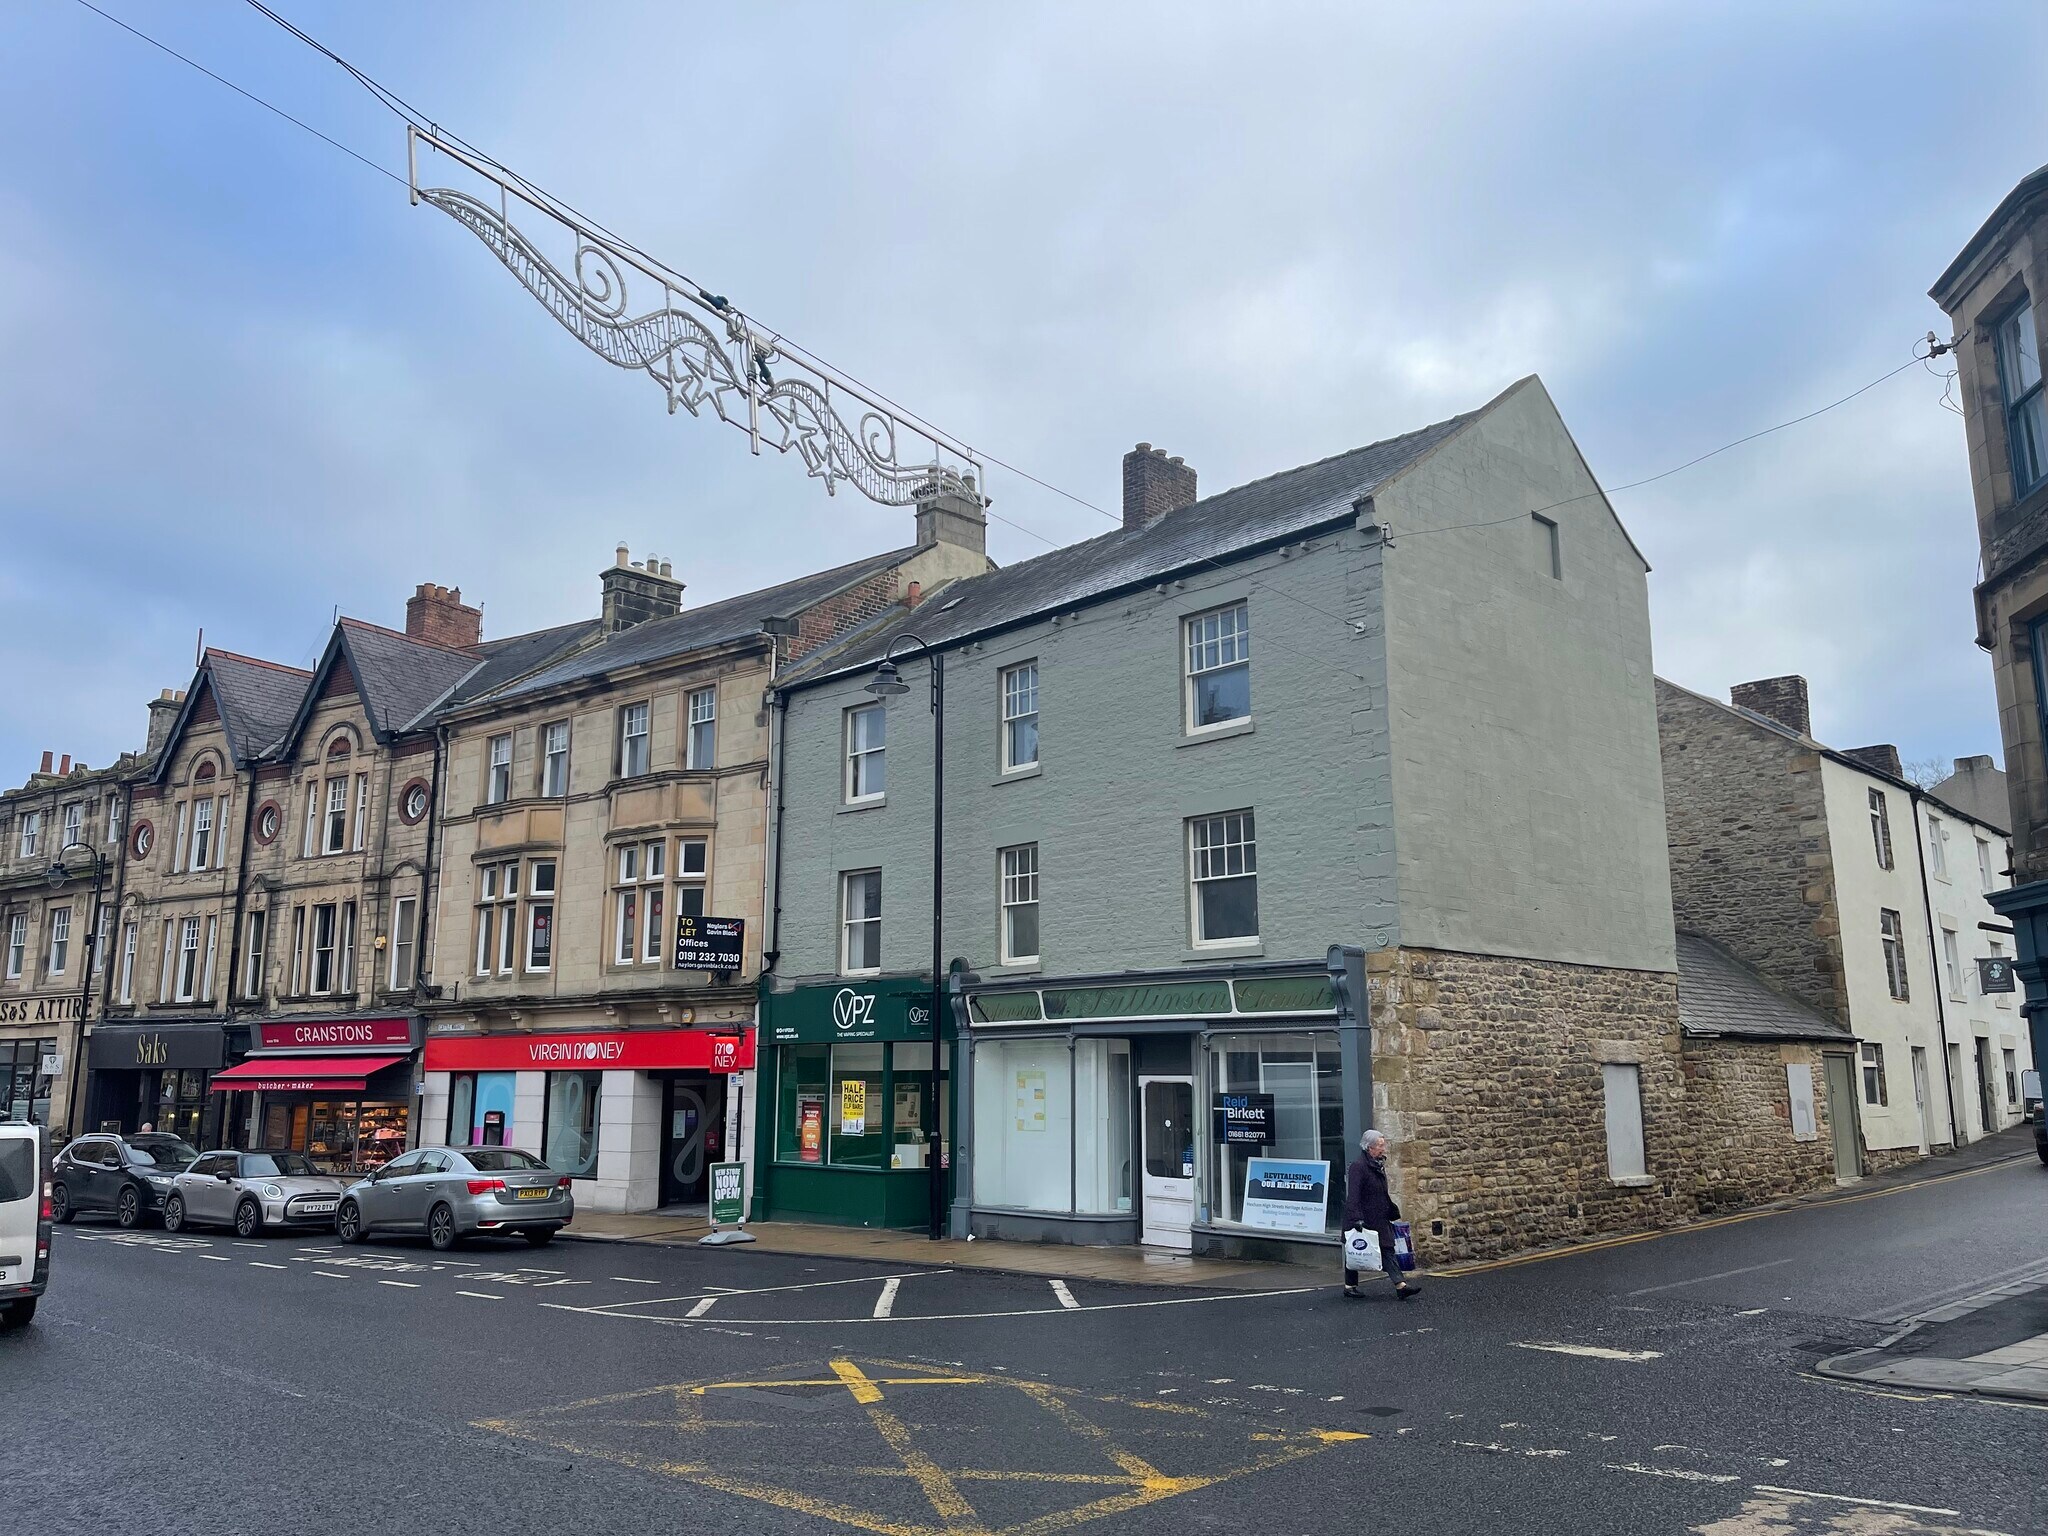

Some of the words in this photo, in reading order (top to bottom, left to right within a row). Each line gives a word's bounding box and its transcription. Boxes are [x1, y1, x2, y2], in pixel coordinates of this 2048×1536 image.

[681, 918, 693, 926] TO
[680, 928, 697, 936] LET
[679, 938, 708, 948] Offices
[678, 952, 696, 960] 0191
[698, 952, 716, 962] 232
[718, 953, 740, 962] 7030
[835, 992, 876, 1027] VPZ
[910, 1008, 929, 1022] VPZ
[295, 1025, 373, 1042] CRANSTONS
[136, 1034, 168, 1064] Saks
[529, 1043, 572, 1060] VIRGIN
[574, 1042, 624, 1060] MONEY
[714, 1056, 737, 1068] NEY
[257, 1082, 286, 1090] butcher
[844, 1084, 864, 1094] HALF
[844, 1094, 864, 1103] PRICE
[1224, 1096, 1248, 1108] Reid
[1227, 1107, 1265, 1120] Birkett
[716, 1175, 740, 1188] NOW
[1264, 1172, 1312, 1181] REVITALISING
[714, 1188, 741, 1200] OPEN!
